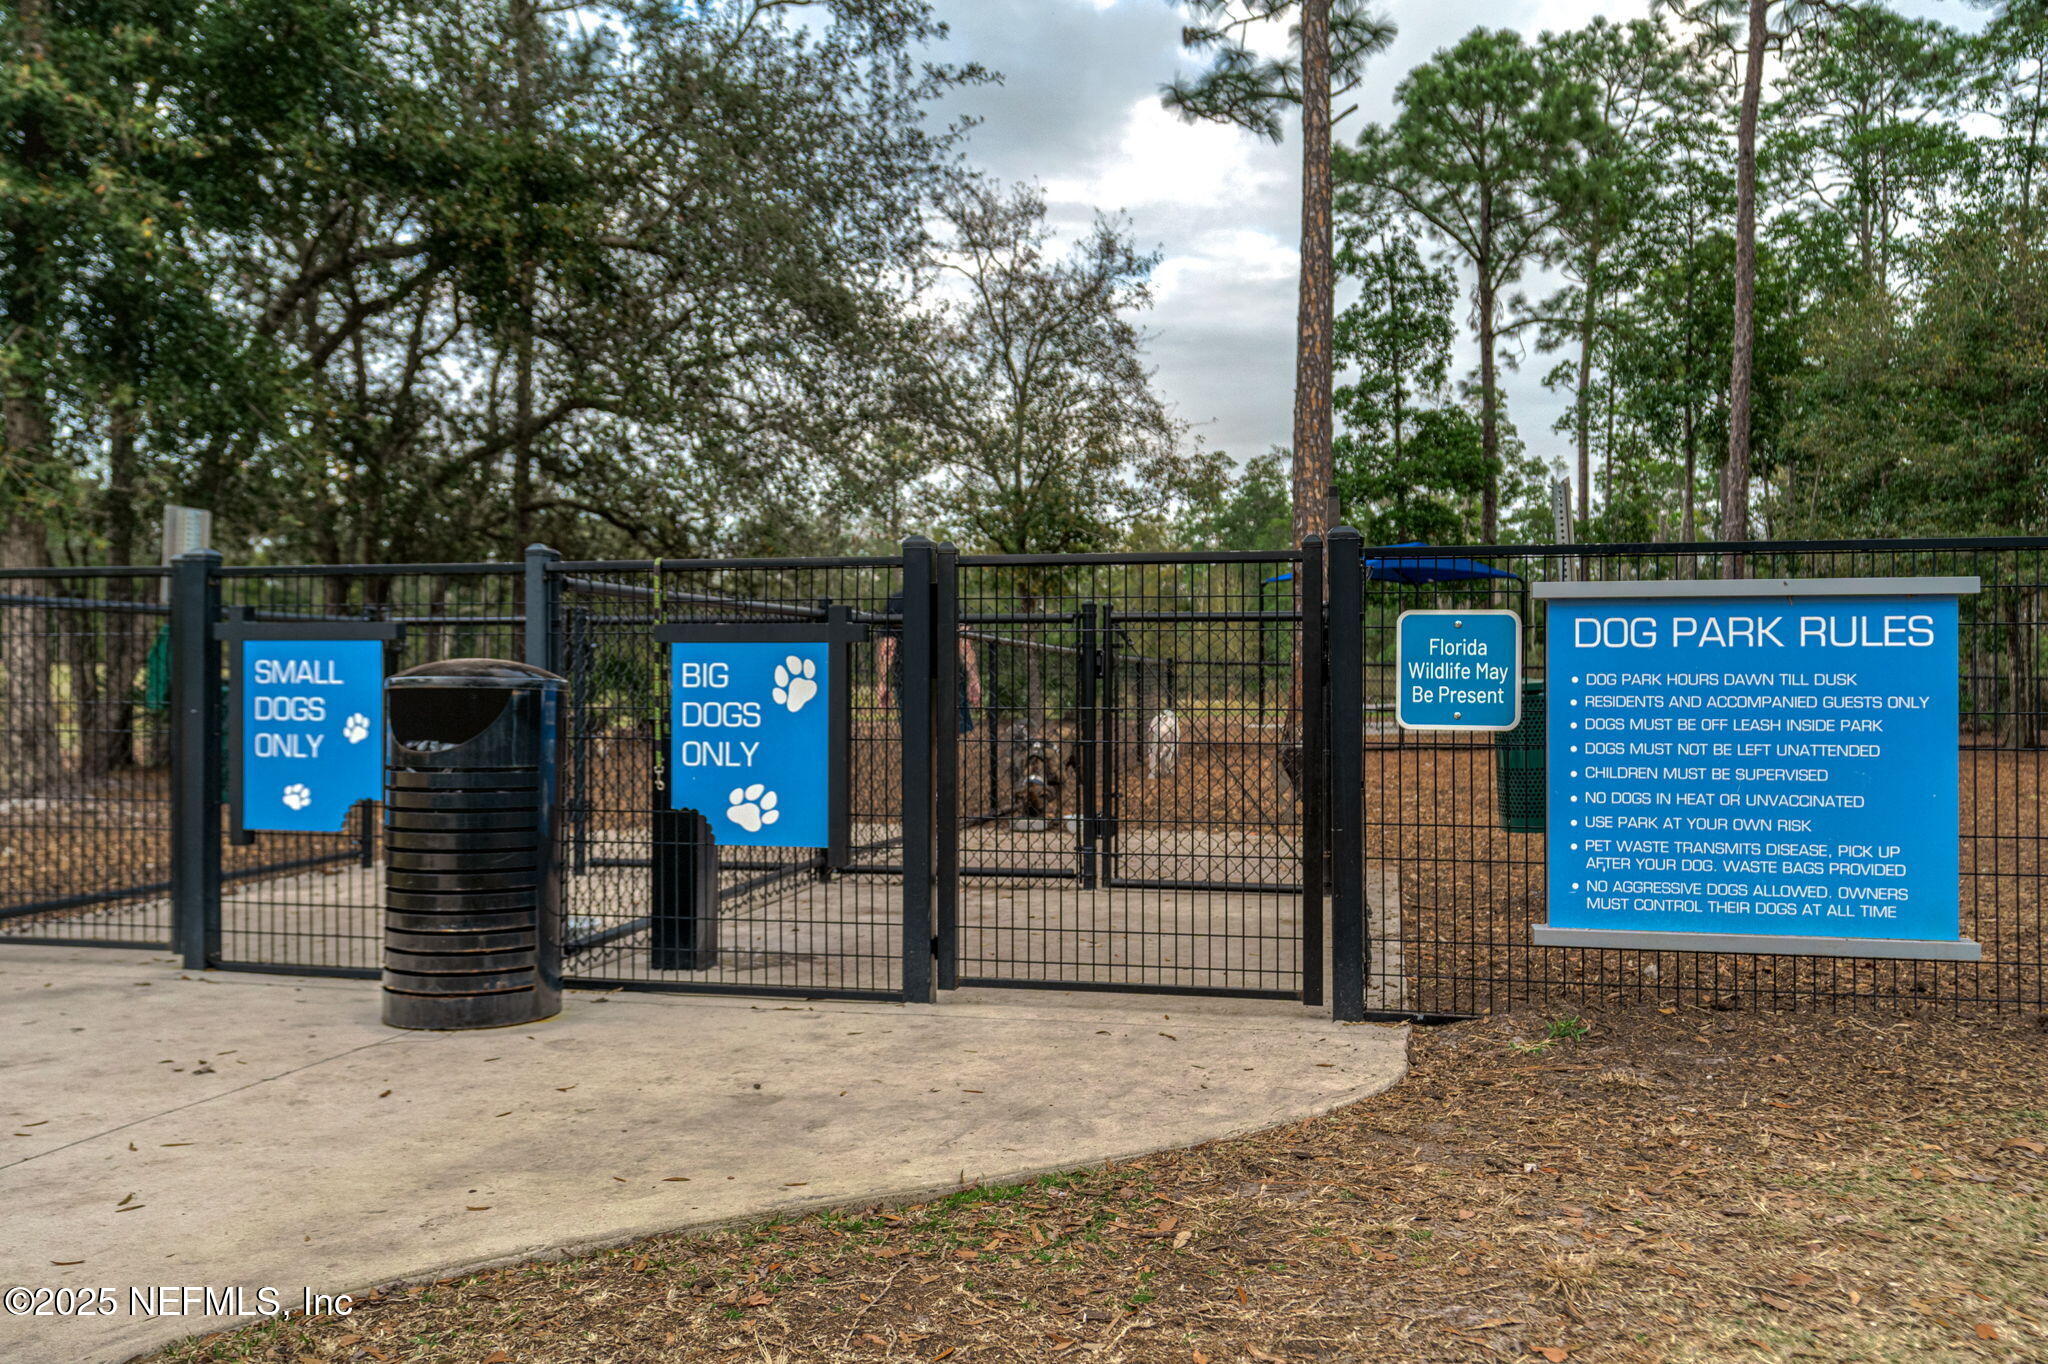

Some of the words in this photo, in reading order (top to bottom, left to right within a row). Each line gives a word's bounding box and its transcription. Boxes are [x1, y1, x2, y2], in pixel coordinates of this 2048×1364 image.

[1575, 618, 1656, 648] DOG
[1673, 617, 1784, 647] PARK
[1801, 615, 1934, 647] RULES
[1430, 639, 1487, 655] Florida
[255, 660, 343, 684] SMALL
[682, 663, 728, 688] BIG
[1408, 662, 1470, 679] Wildlife
[1477, 663, 1508, 684] May
[1587, 674, 1616, 685] DOG
[1622, 674, 1661, 685] PARK
[1667, 674, 1718, 685] HOURS
[1724, 674, 1773, 685] DAWN
[1780, 674, 1809, 685] TILL
[1815, 674, 1856, 685] DUSK
[1413, 686, 1433, 702] Be
[1439, 686, 1504, 703] Present
[1586, 696, 1664, 707] RESIDENTS
[1669, 696, 1701, 707] AND
[1707, 696, 1817, 708] ACCOMPANIED
[1823, 696, 1882, 708] GUESTS
[1888, 696, 1929, 708] ONLY
[255, 697, 325, 721] DOGS
[682, 702, 761, 727] DOGS
[1585, 718, 1624, 730] DOGS
[1630, 719, 1672, 730] MUST
[1678, 719, 1696, 730] BE
[1702, 719, 1728, 730] OFF
[1734, 719, 1780, 731] LEASH
[1787, 720, 1835, 731] INSIDE
[1841, 720, 1882, 731] PARK
[255, 733, 323, 758] ONLY
[682, 741, 759, 766] ONLY
[1585, 743, 1624, 754] DOGS
[1630, 743, 1672, 755] MUST
[1678, 744, 1708, 755] NOT
[1714, 744, 1731, 755] BE
[1738, 744, 1771, 755] LEFT
[1777, 745, 1880, 757] UNATTENDED
[1586, 767, 1657, 779] CHILDREN
[1664, 768, 1706, 779] MUST
[1712, 768, 1730, 780] BE
[1736, 768, 1828, 781] SUPERVISED
[1586, 792, 1606, 803] NO
[1612, 792, 1651, 804] DOGS
[1657, 793, 1670, 804] IN
[1677, 794, 1715, 805] HEAT
[1720, 794, 1740, 805] OR
[1746, 795, 1864, 808] UNVACCINATED
[1586, 816, 1613, 828] USE
[1618, 817, 1657, 828] PARK
[1663, 818, 1682, 829] AT
[1687, 818, 1727, 830] YOUR
[1733, 819, 1771, 831] OWN
[1778, 820, 1811, 831] RISK
[1586, 840, 1611, 851] PET
[1616, 841, 1668, 853] WASTE
[1674, 842, 1760, 855] TRANSMITS
[1766, 844, 1831, 857] DISEASE,
[1839, 845, 1872, 857] PICK
[1879, 846, 1900, 858] UP
[1586, 857, 1630, 871] AFTER
[1636, 859, 1676, 870] YOUR
[1682, 860, 1717, 871] DOG.
[1723, 861, 1776, 873] WASTE
[1783, 862, 1824, 874] BAGS
[1830, 863, 1906, 876] PROVIDED
[1587, 880, 1607, 892] NO
[1613, 881, 1701, 894] AGGRESSIVE
[1707, 884, 1748, 896] DOGS
[1753, 885, 1832, 898] ALLOWED.
[1839, 887, 1908, 900] OWNERS
[1587, 898, 1629, 909] MUST
[1634, 899, 1702, 912] CONTROL
[1708, 901, 1749, 913] THEIR
[1756, 903, 1797, 915] DOGS
[1802, 904, 1821, 915] AT
[1827, 905, 1854, 916] ALL
[1860, 905, 1896, 918] TIME
